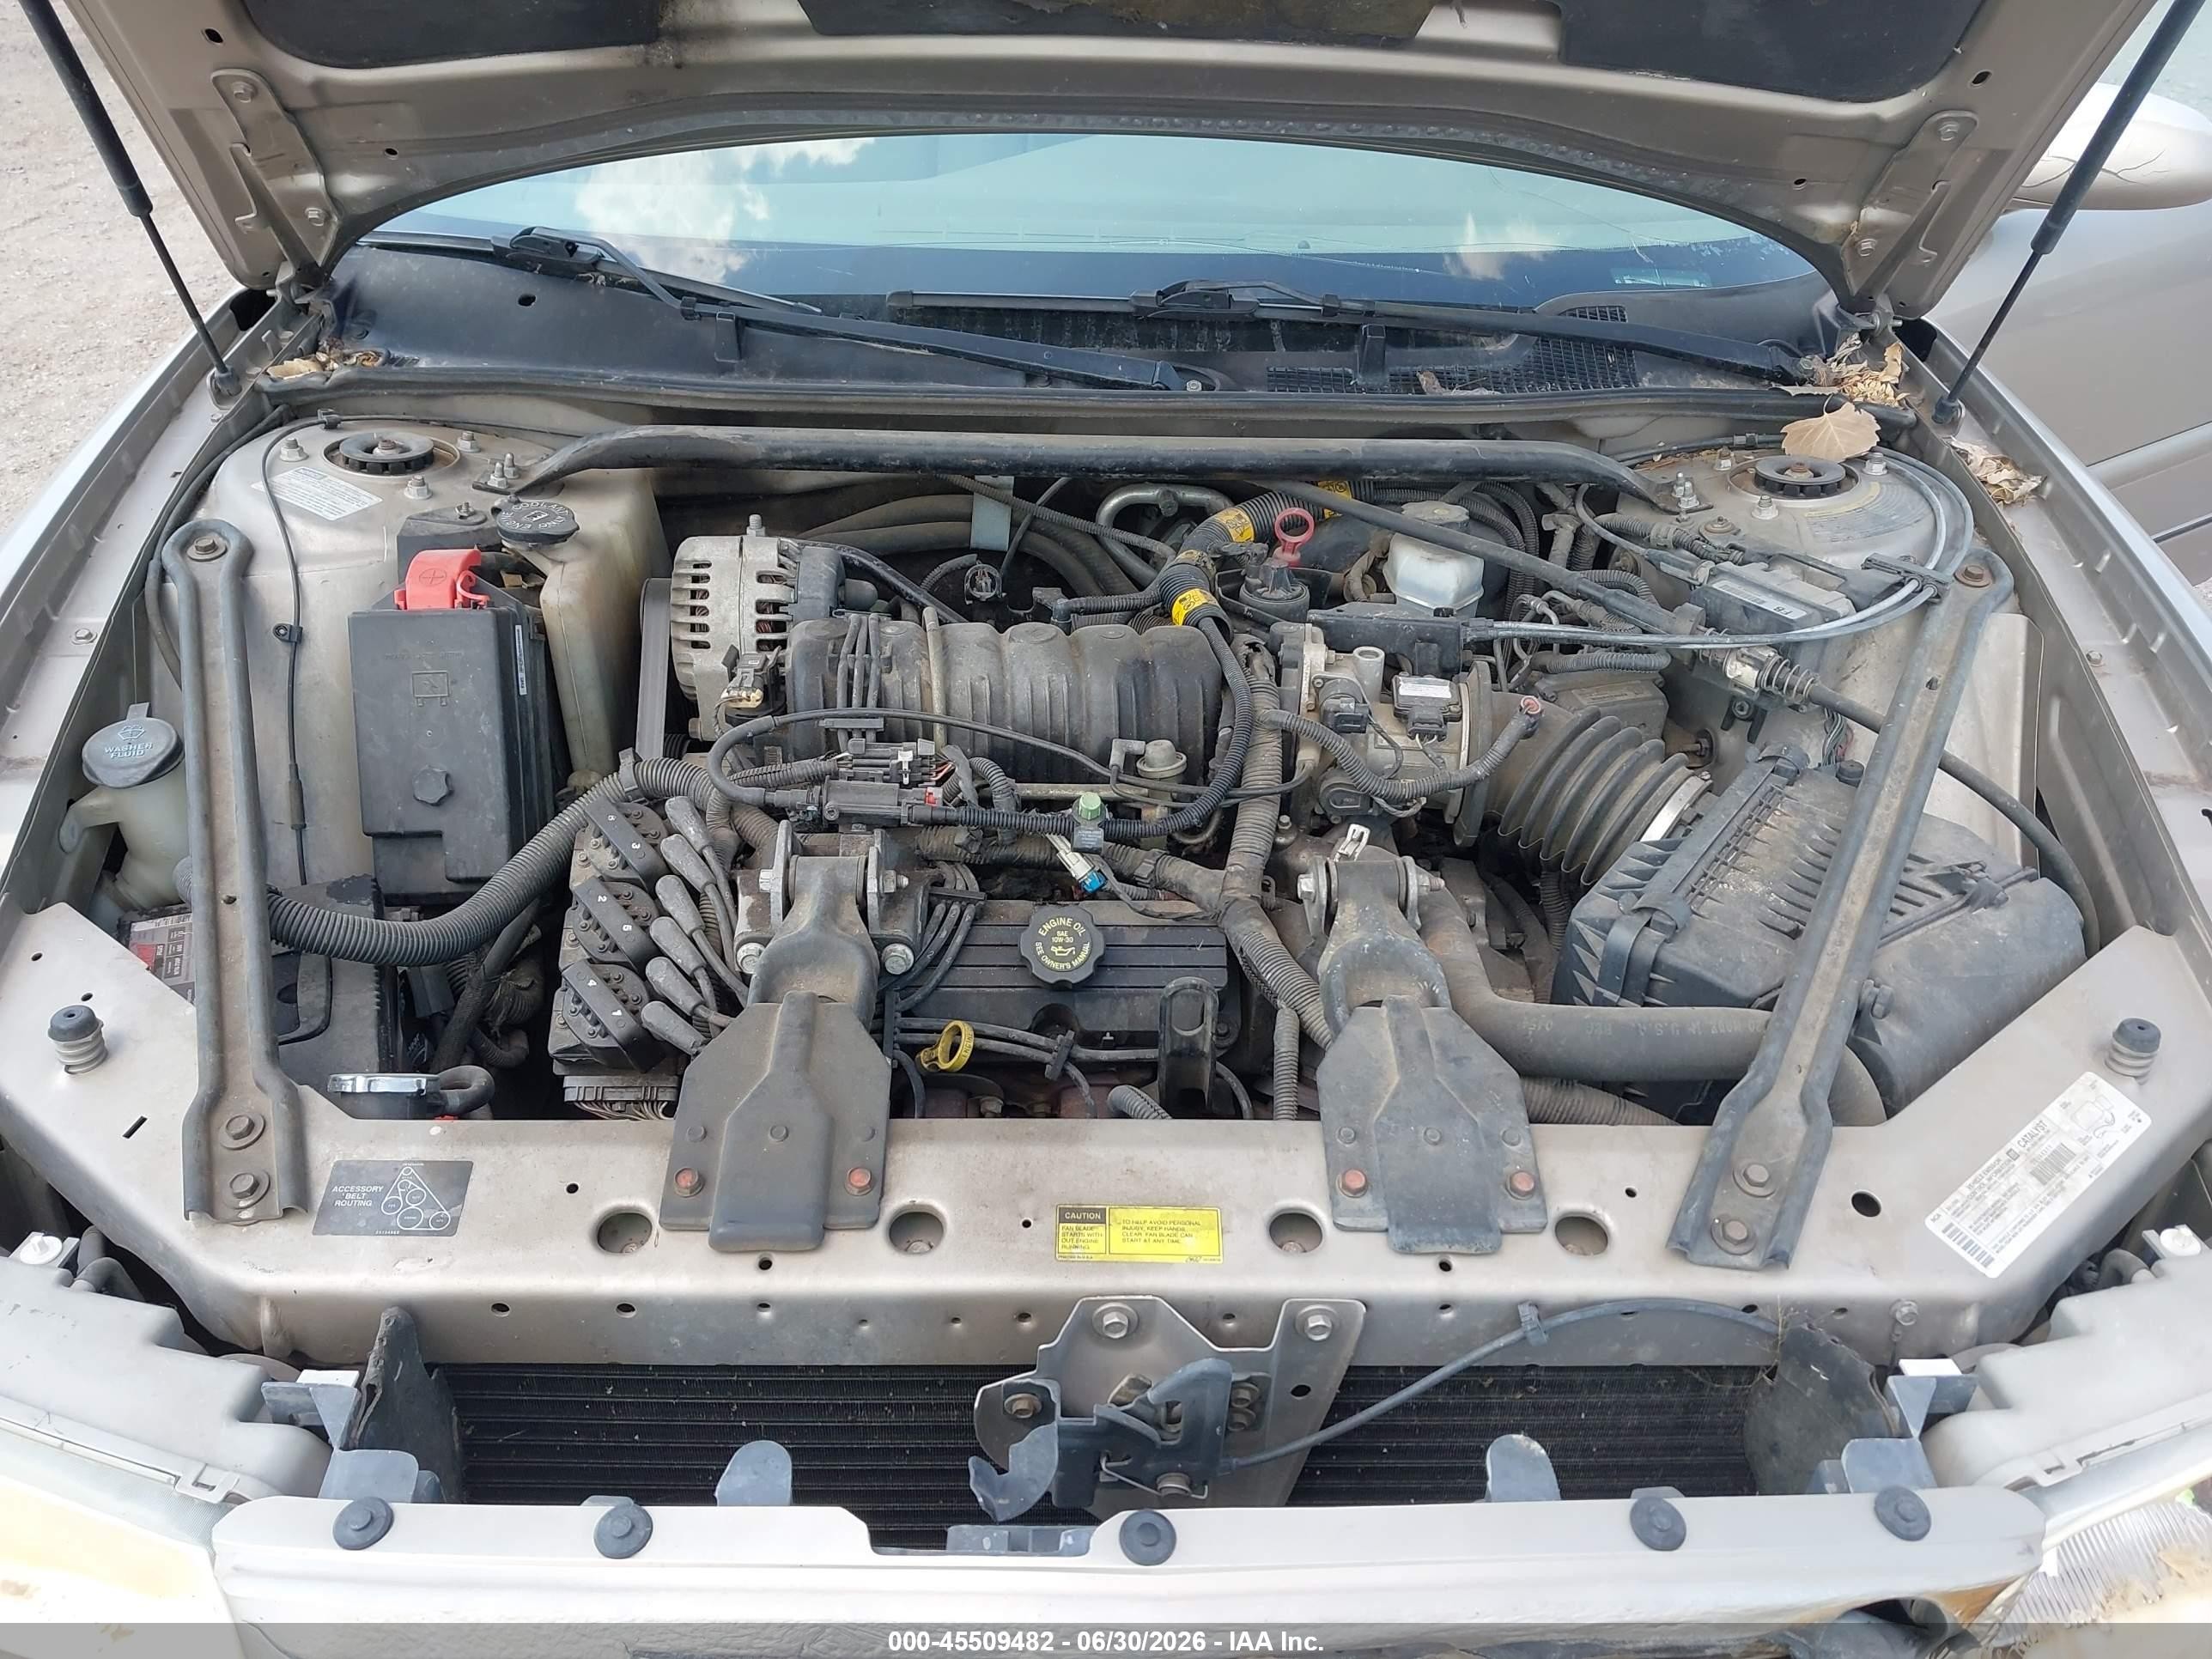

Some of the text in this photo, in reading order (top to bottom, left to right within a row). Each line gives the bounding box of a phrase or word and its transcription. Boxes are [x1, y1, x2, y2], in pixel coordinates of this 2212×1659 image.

[512, 501, 568, 515] COOLANT
[501, 512, 532, 529] ENGINE
[105, 742, 153, 754] WASHER
[110, 750, 145, 759] FLUID
[1038, 917, 1086, 937] ENGINE OIL
[1035, 942, 1090, 969] SEE OWNER'S MANUAL
[2017, 1120, 2048, 1148] CATALYST
